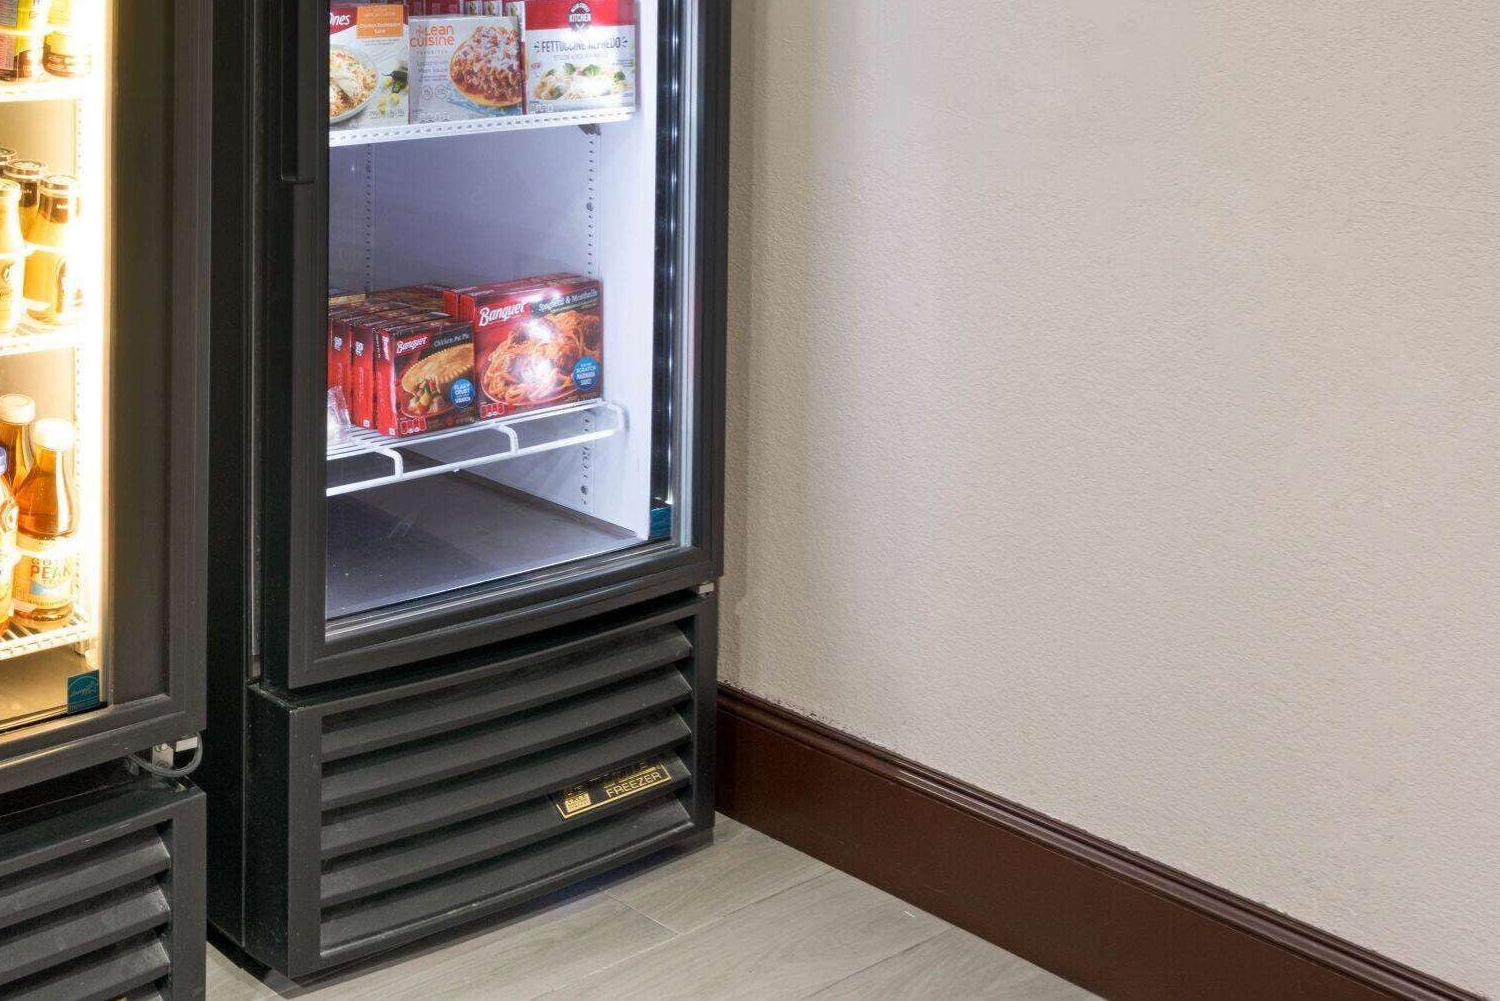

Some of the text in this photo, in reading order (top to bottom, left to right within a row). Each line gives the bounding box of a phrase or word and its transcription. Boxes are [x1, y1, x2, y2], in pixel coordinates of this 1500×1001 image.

[425, 24, 454, 36] Lean
[409, 35, 455, 48] cuisine
[478, 301, 528, 327] Banquet
[605, 771, 662, 798] FREEZER
